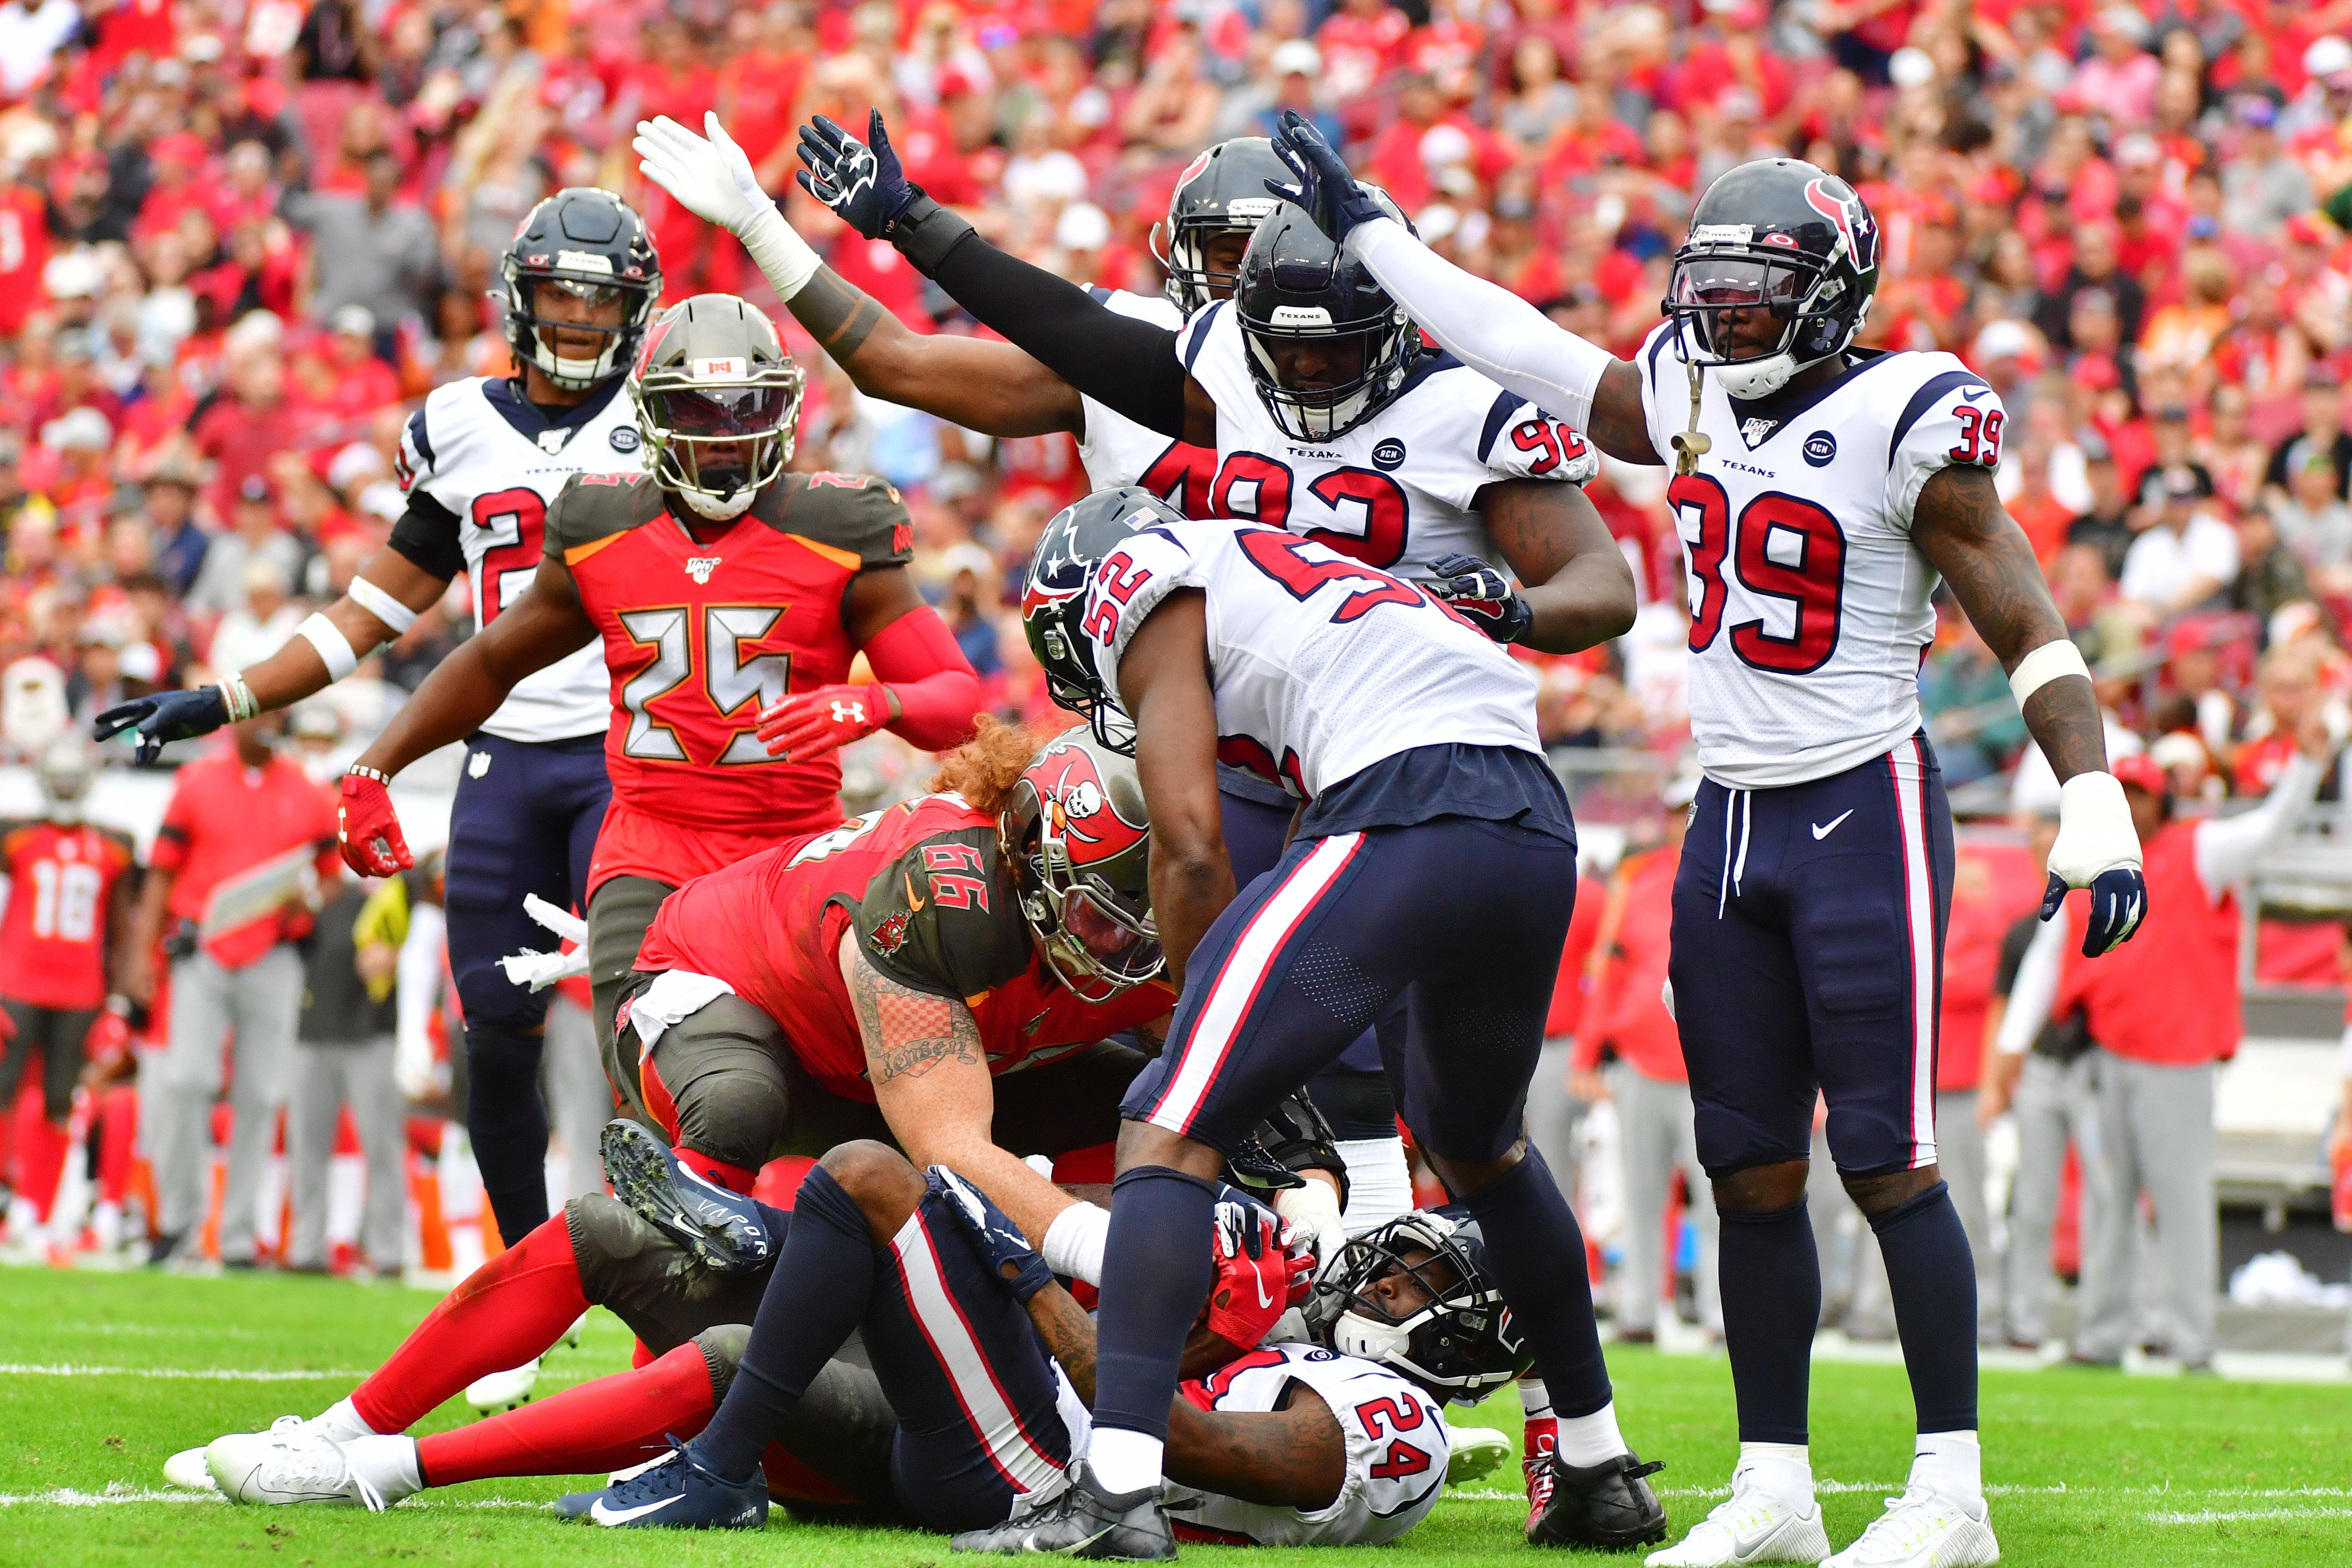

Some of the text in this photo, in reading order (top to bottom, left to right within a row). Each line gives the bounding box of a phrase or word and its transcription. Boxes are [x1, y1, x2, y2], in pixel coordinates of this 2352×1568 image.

[1285, 446, 1344, 459] TEXANS
[1511, 419, 1588, 475] 92
[1810, 443, 1829, 454] RCM
[1949, 405, 2004, 466] 39
[1721, 459, 1777, 479] TEXANS
[1083, 551, 1153, 647] 52
[1667, 472, 1847, 675] 39
[613, 602, 792, 767] 25
[920, 842, 990, 914] 66
[697, 1199, 768, 1255] VAPOR
[1355, 1391, 1432, 1484] 24
[731, 1506, 757, 1525] VAPOR
